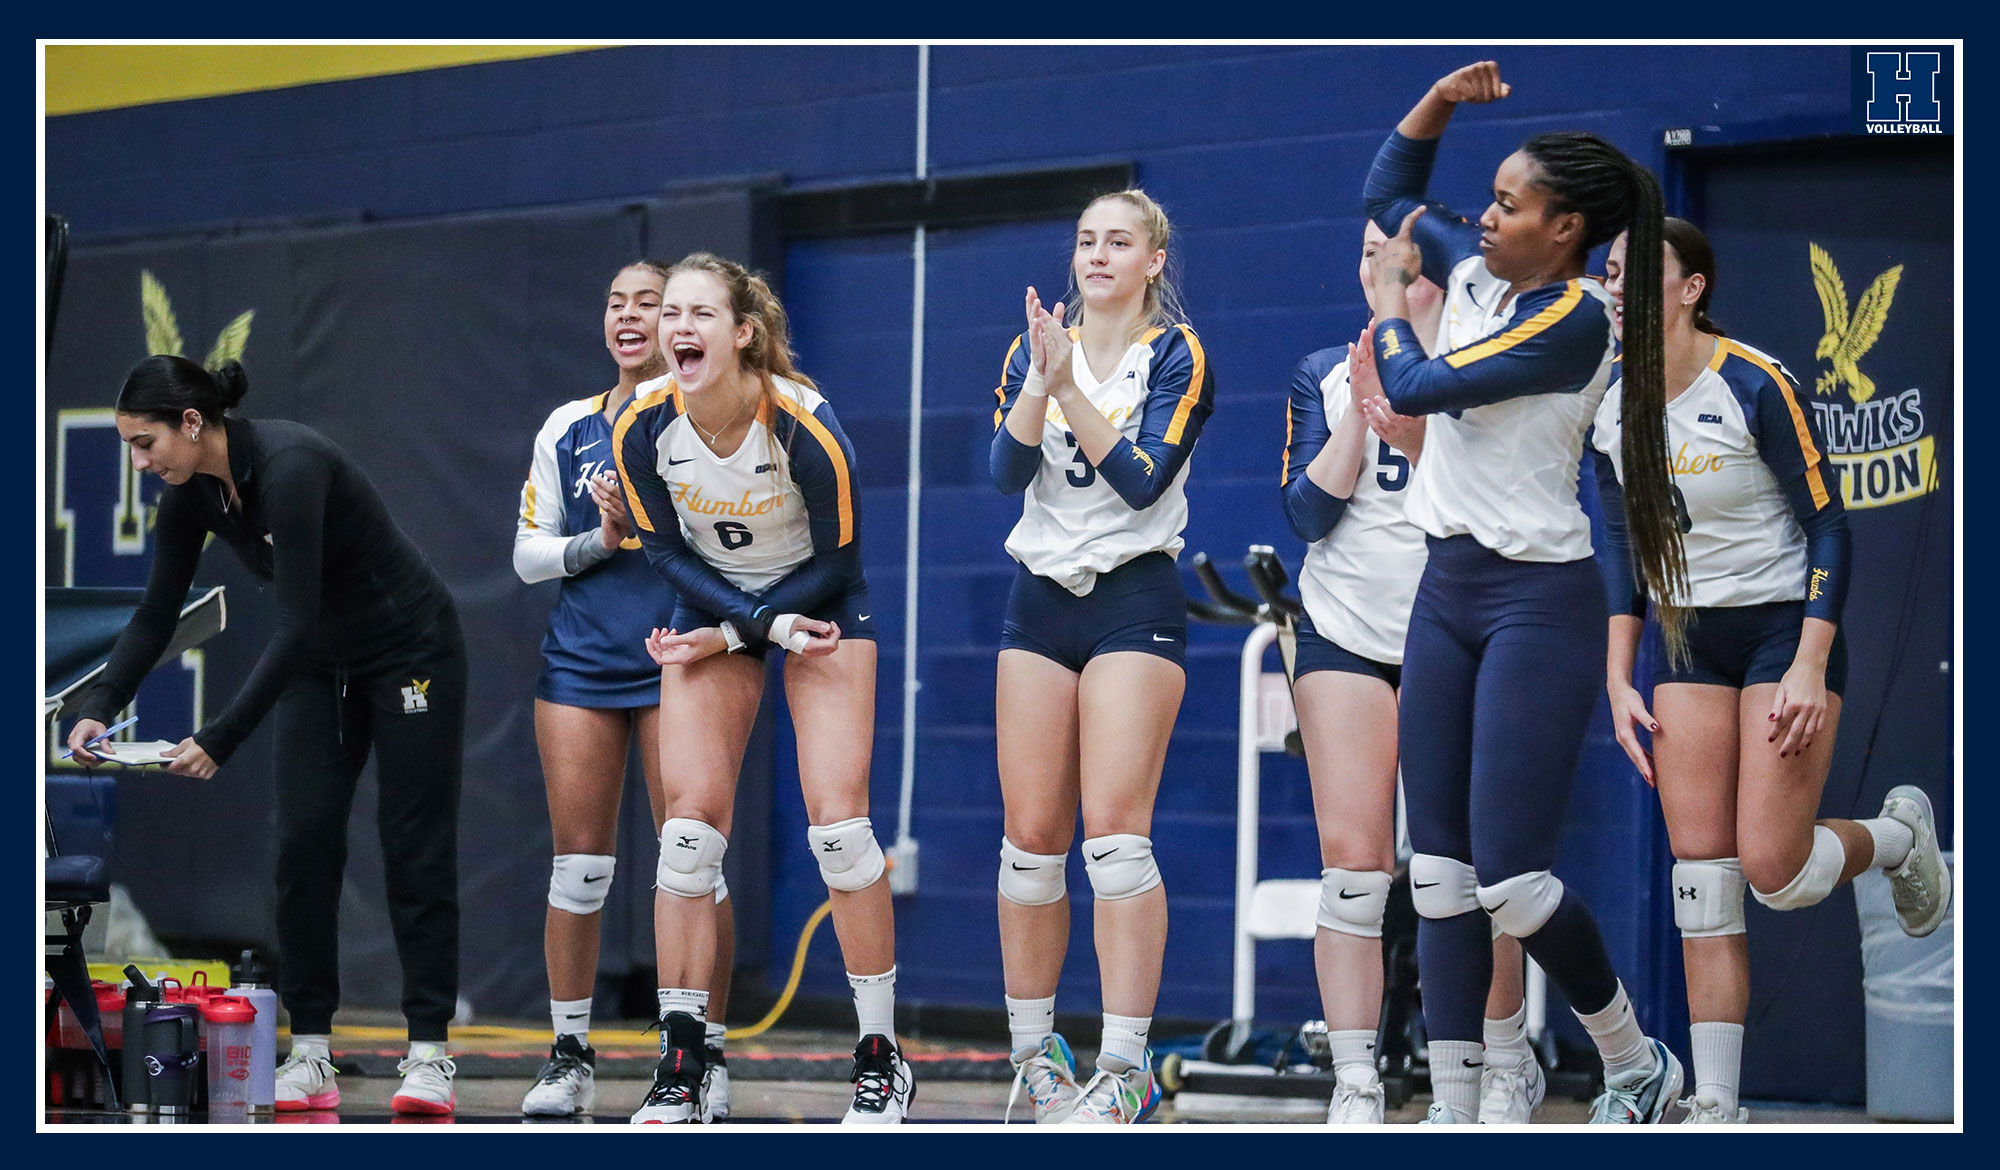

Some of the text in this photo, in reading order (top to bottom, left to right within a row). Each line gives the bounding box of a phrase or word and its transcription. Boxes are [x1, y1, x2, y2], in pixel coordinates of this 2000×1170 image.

[1697, 413, 1723, 425] OCAA
[1810, 388, 1924, 453] AWKS
[1065, 430, 1096, 488] 3
[1376, 437, 1410, 492] 5
[1830, 440, 1922, 506] TION
[673, 481, 788, 517] Humber
[713, 520, 754, 551] 6
[1809, 567, 1829, 602] Hawks
[401, 686, 428, 709] H
